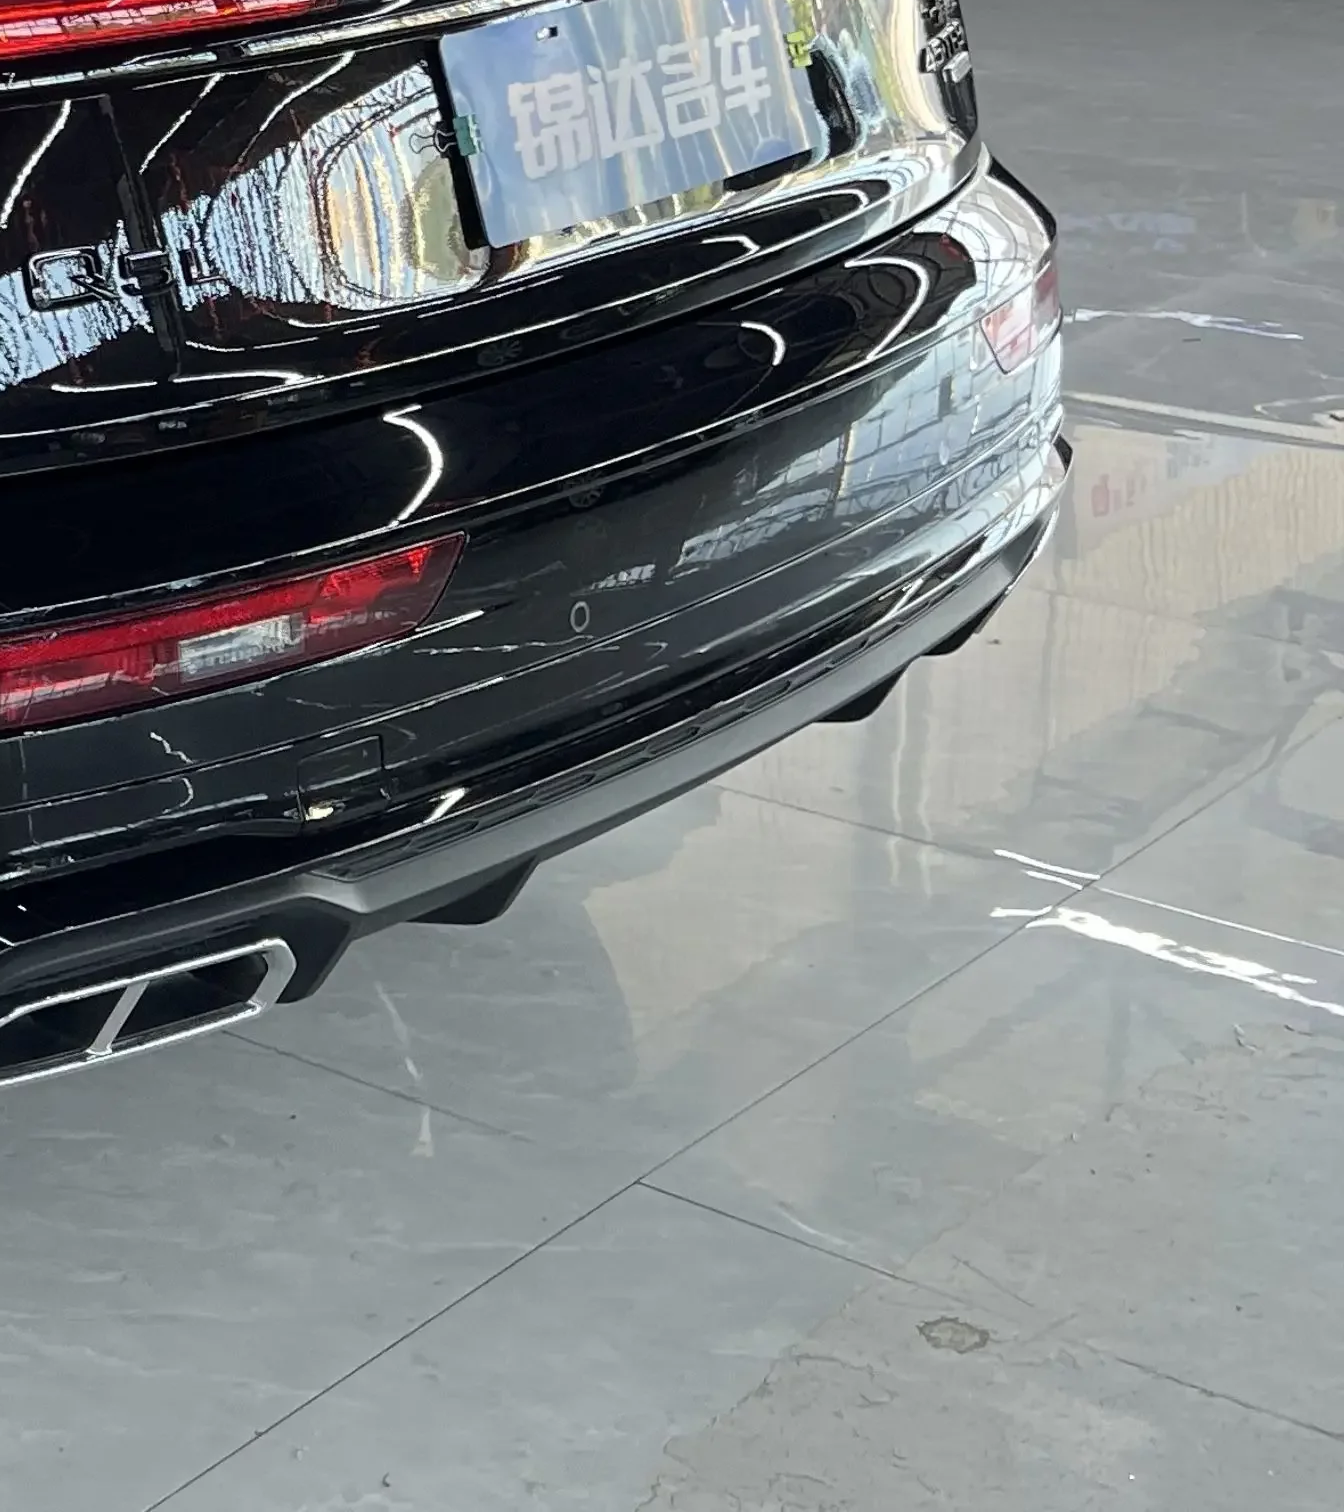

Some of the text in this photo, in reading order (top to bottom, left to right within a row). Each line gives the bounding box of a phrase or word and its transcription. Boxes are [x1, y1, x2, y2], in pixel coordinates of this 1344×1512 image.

[507, 23, 773, 181] 锦达名车
[22, 244, 229, 313] Q5L
